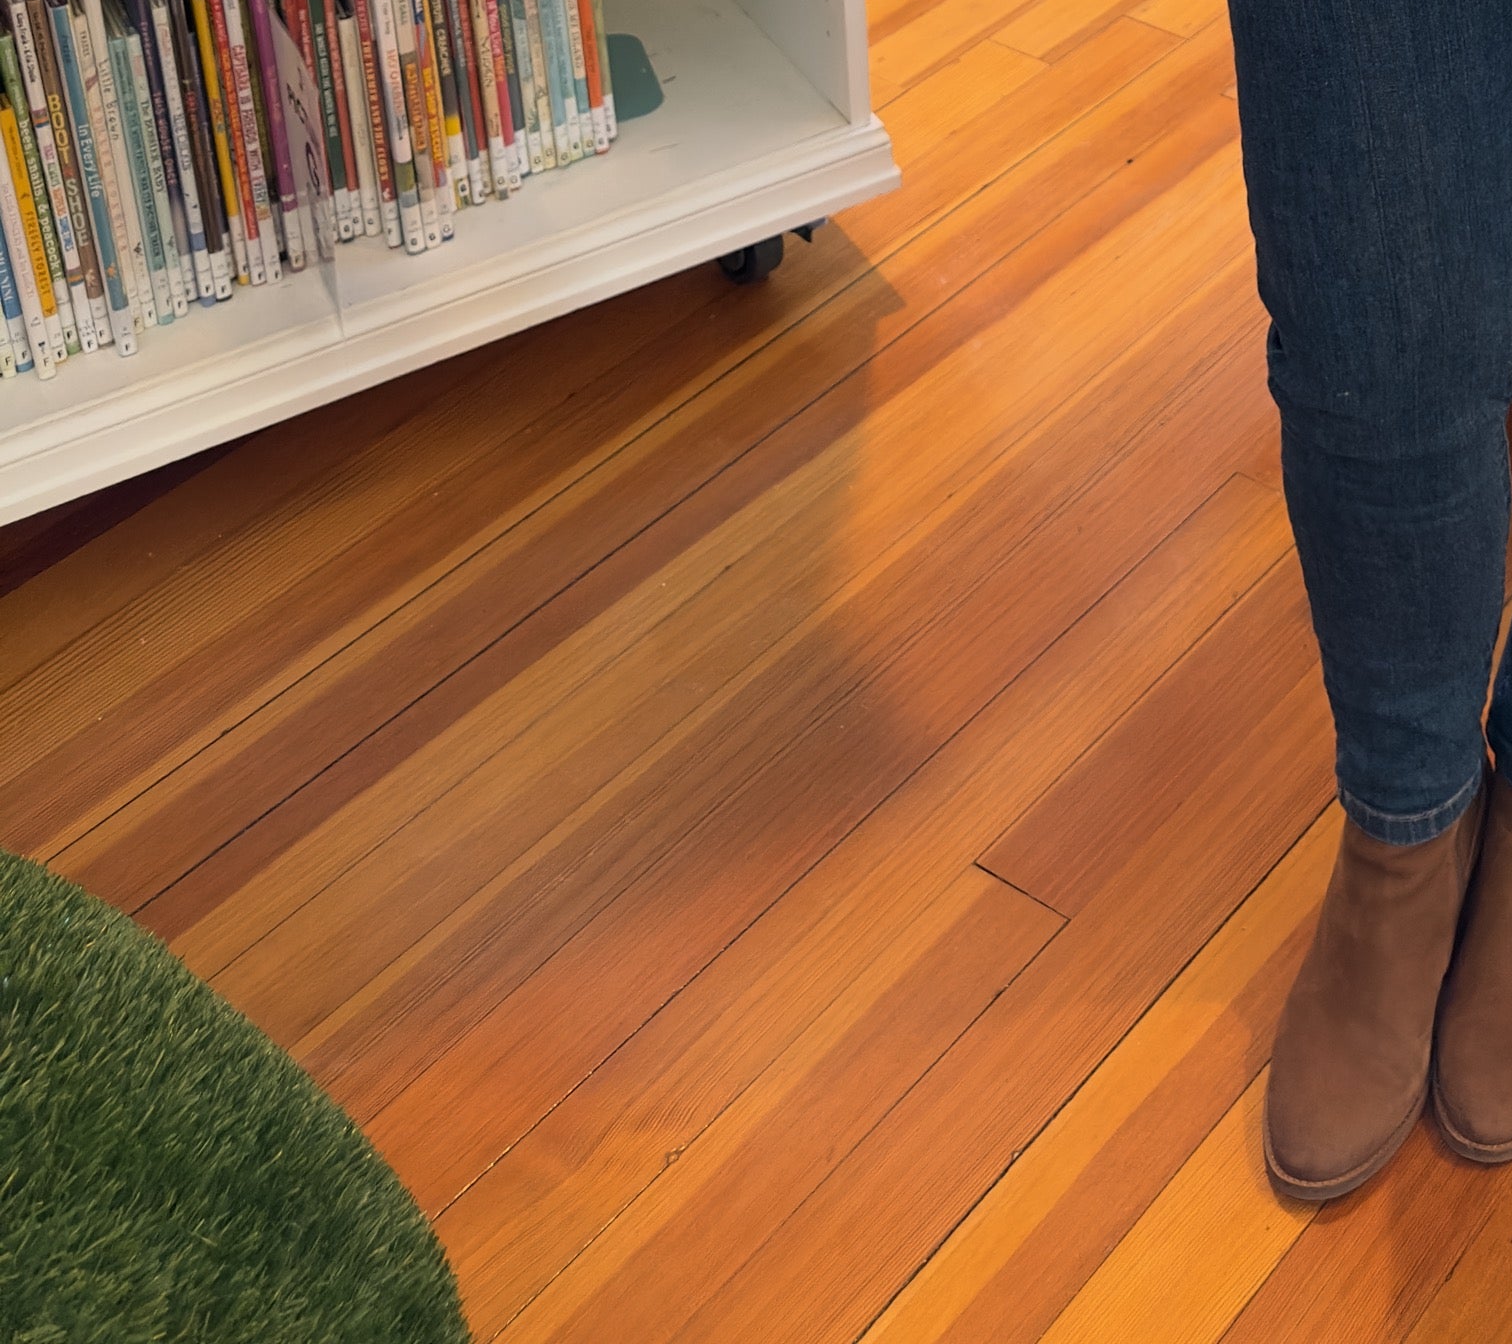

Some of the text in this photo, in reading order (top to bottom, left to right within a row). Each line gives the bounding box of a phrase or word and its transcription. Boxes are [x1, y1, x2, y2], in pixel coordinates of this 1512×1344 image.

[48, 94, 91, 247] BOOT SHOE
[78, 123, 101, 199] In Every Life
